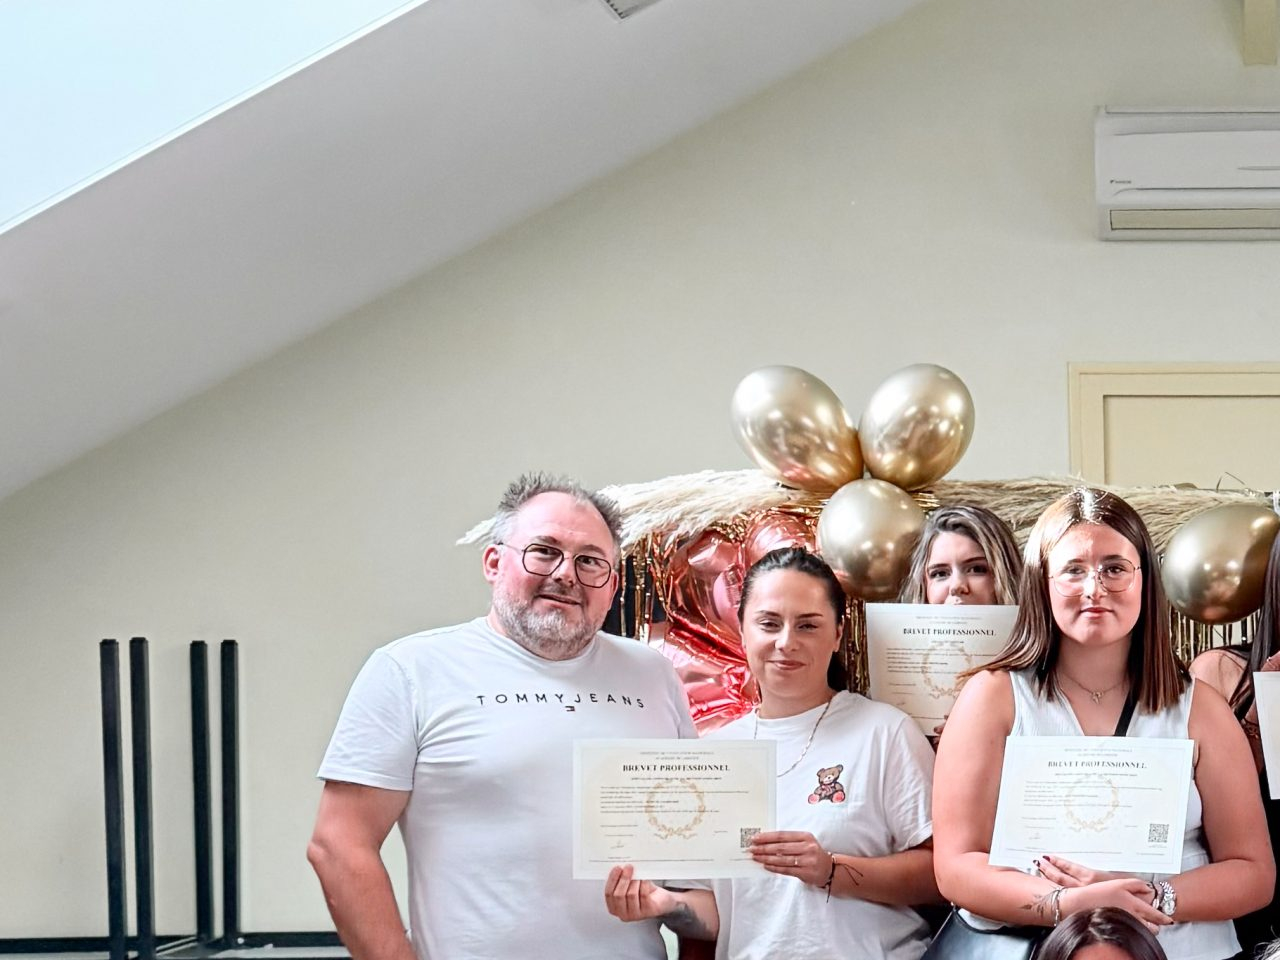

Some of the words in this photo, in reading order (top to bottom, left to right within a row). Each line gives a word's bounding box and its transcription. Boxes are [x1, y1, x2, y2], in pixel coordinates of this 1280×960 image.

[933, 628, 997, 637] PROFESSIONNEL
[476, 693, 564, 706] TOMMY
[574, 693, 645, 708] JEANS
[622, 764, 658, 772] BREVET
[659, 764, 731, 772] PROFESSIONNEL
[1047, 760, 1079, 768] BREVET
[1080, 760, 1148, 770] PROFESSIONNEL
